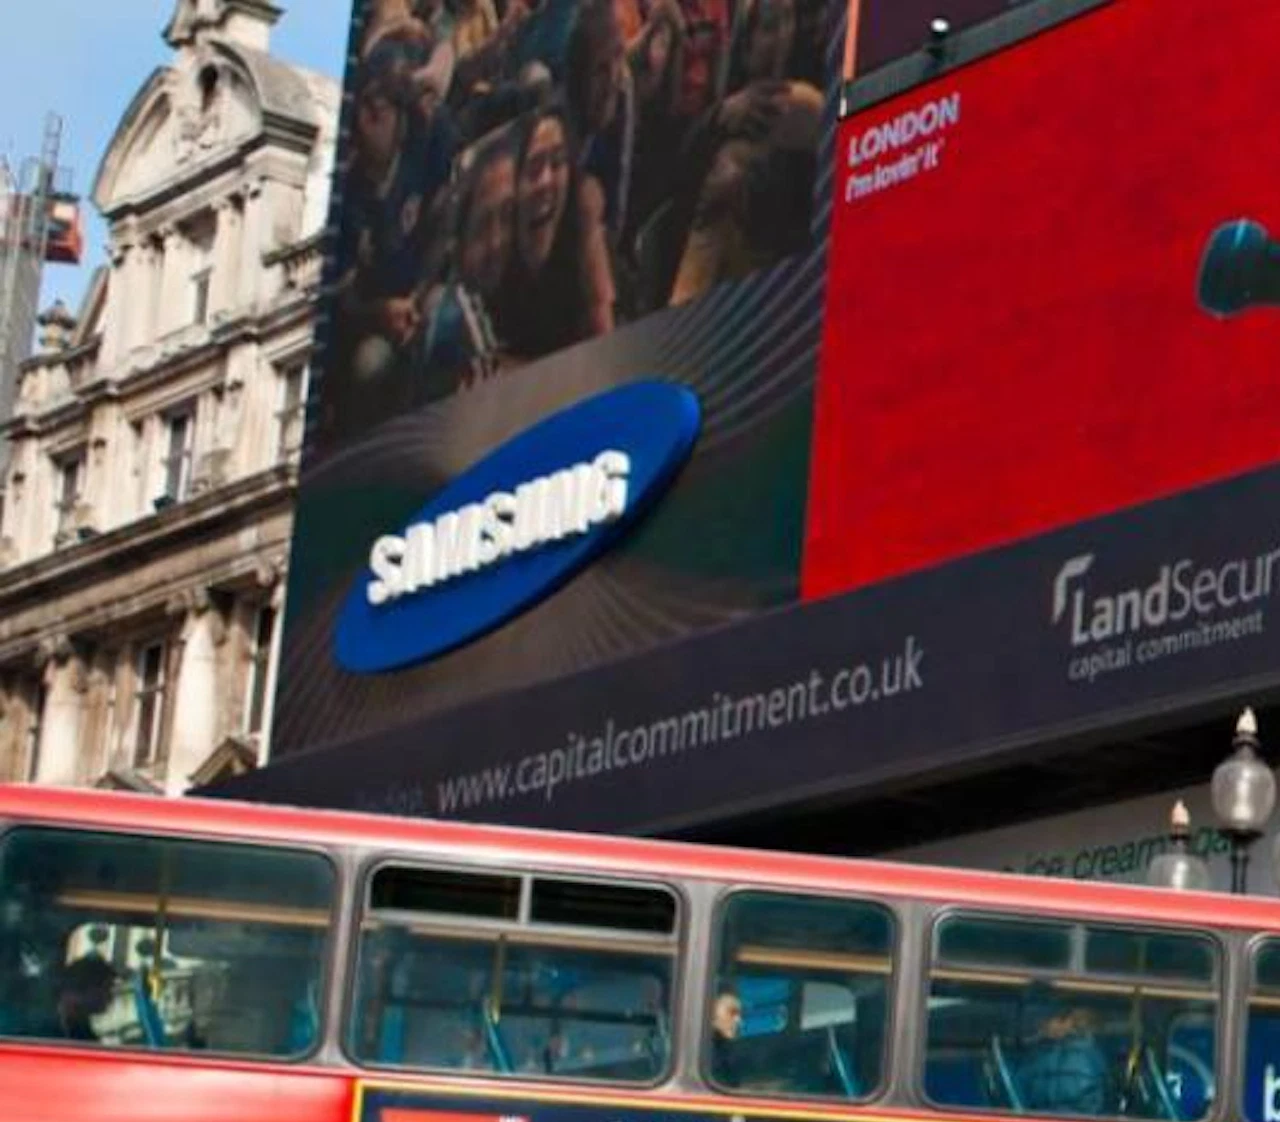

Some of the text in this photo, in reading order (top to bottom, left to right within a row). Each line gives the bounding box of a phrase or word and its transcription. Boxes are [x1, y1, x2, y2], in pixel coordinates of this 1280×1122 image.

[848, 92, 960, 166] LONDON
[367, 450, 630, 604] SAMSUNG
[1068, 611, 1264, 682] capital commitment
[436, 636, 924, 813] www.capitalcommitment.co.uk
